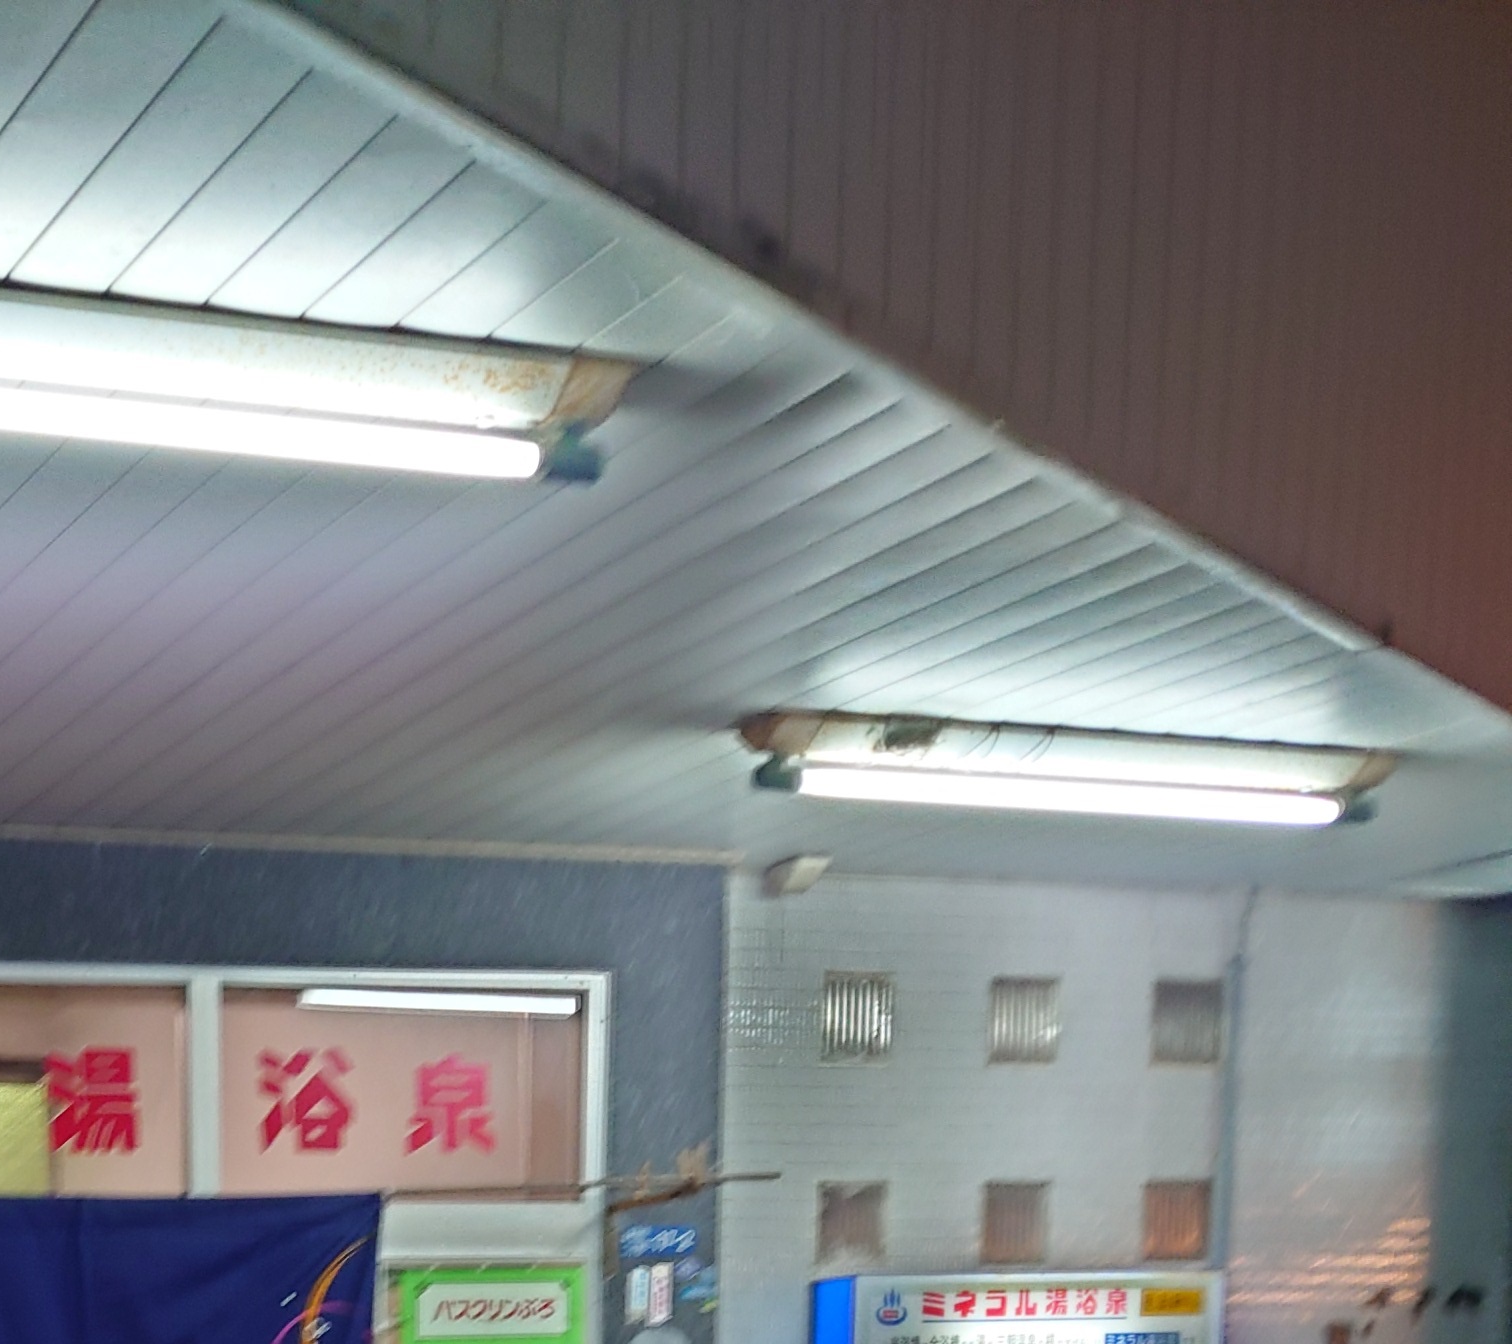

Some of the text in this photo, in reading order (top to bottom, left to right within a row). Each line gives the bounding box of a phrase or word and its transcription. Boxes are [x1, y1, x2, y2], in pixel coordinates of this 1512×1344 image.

[922, 1288, 1128, 1317] ミネラル湯浴泉
